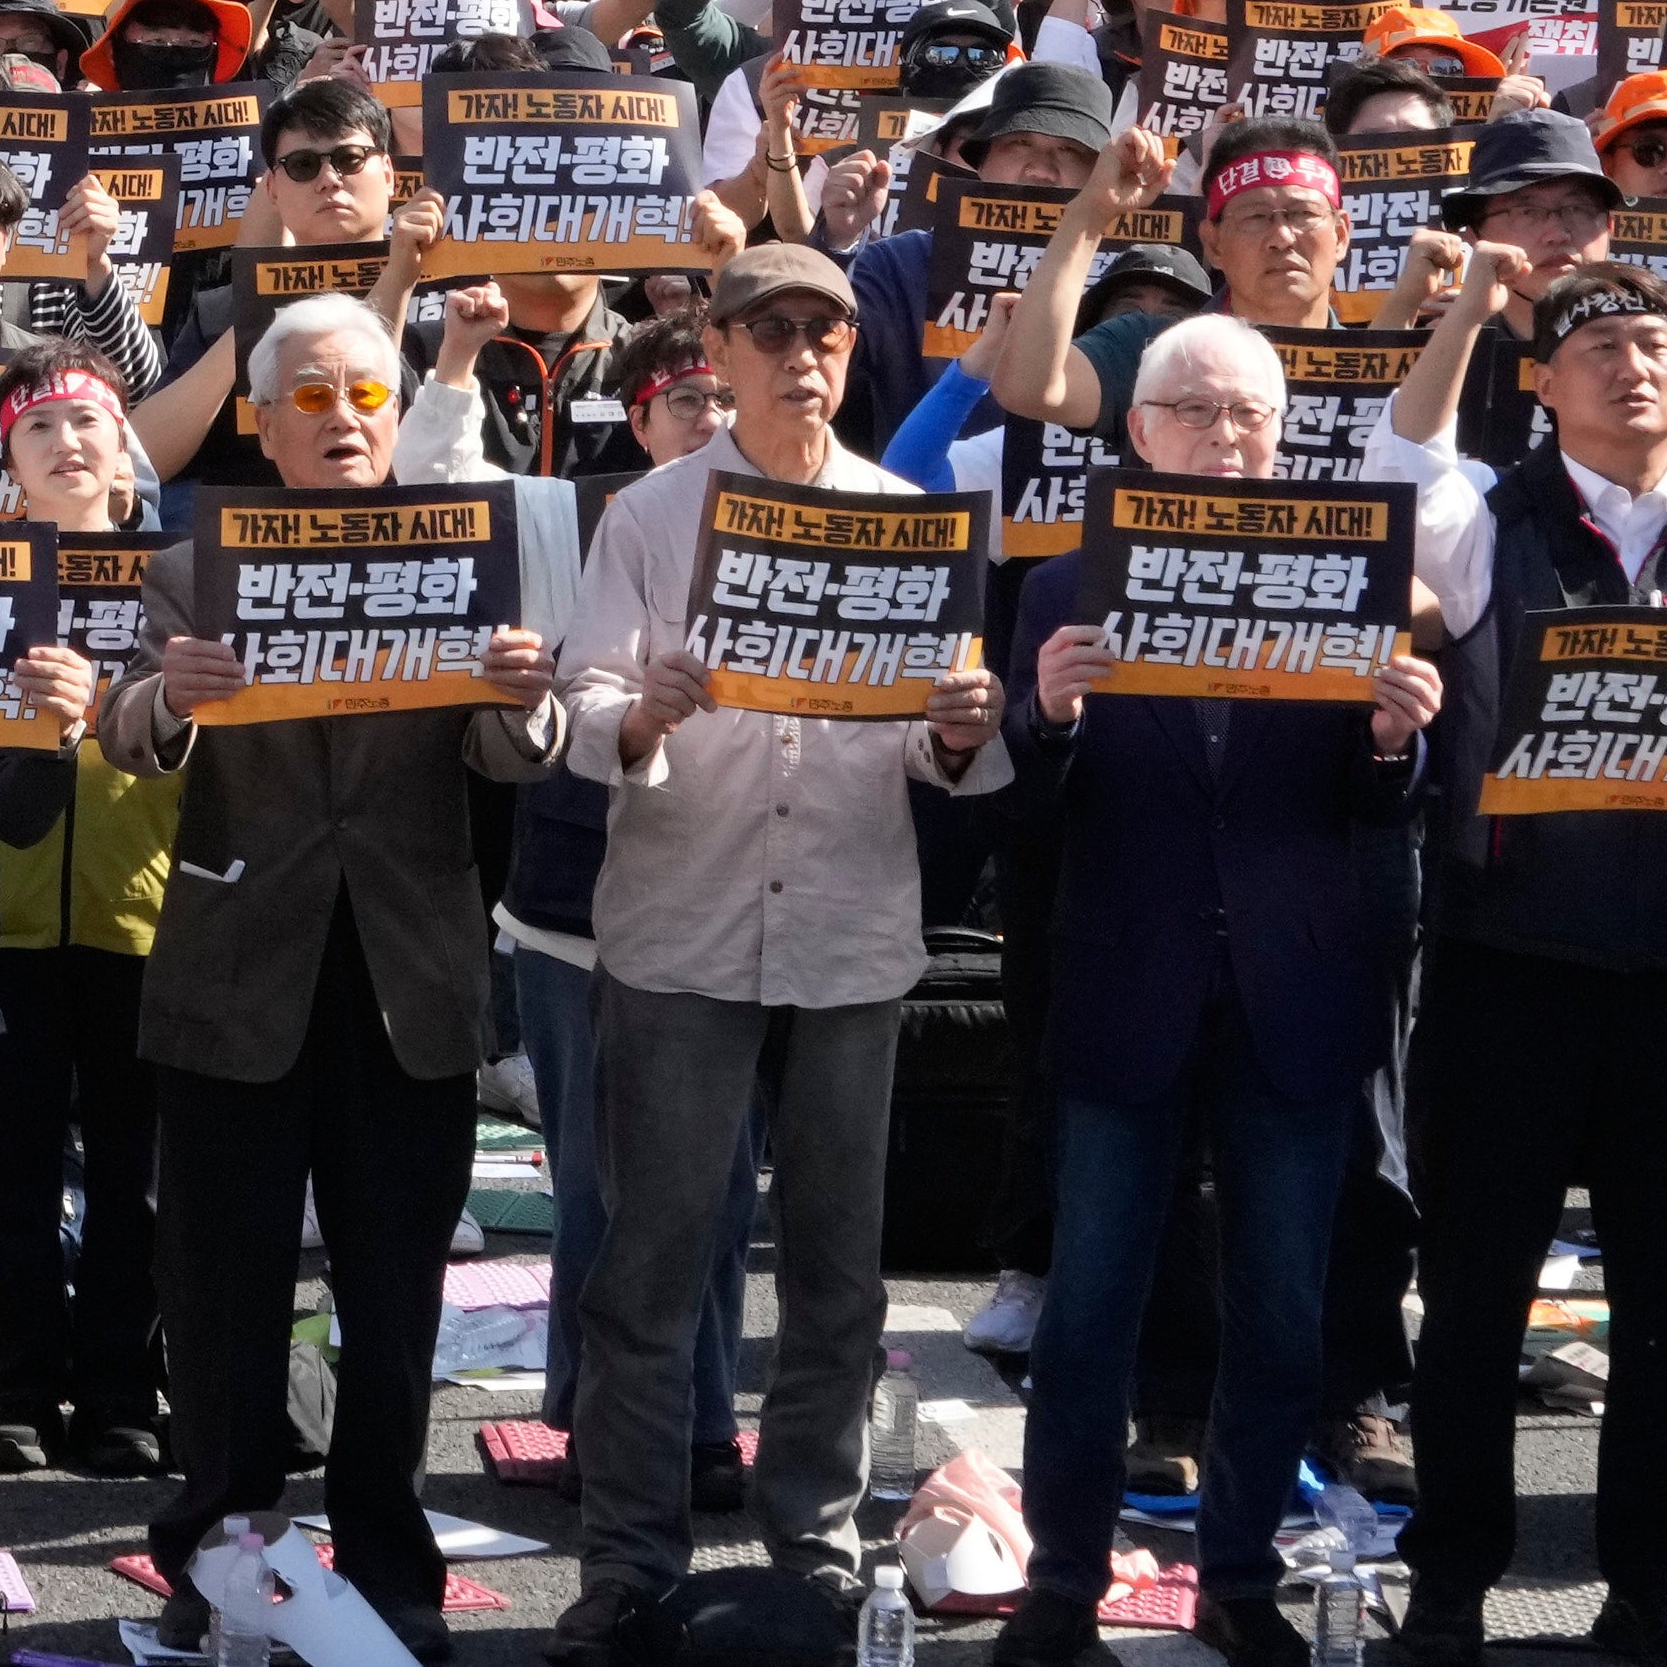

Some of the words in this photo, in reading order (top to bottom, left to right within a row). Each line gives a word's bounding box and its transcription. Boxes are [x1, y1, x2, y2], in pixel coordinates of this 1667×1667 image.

[457, 93, 519, 121] 가자!
[525, 94, 605, 121] 노동자
[612, 97, 667, 123] 시대!
[1217, 156, 1261, 193] 단결
